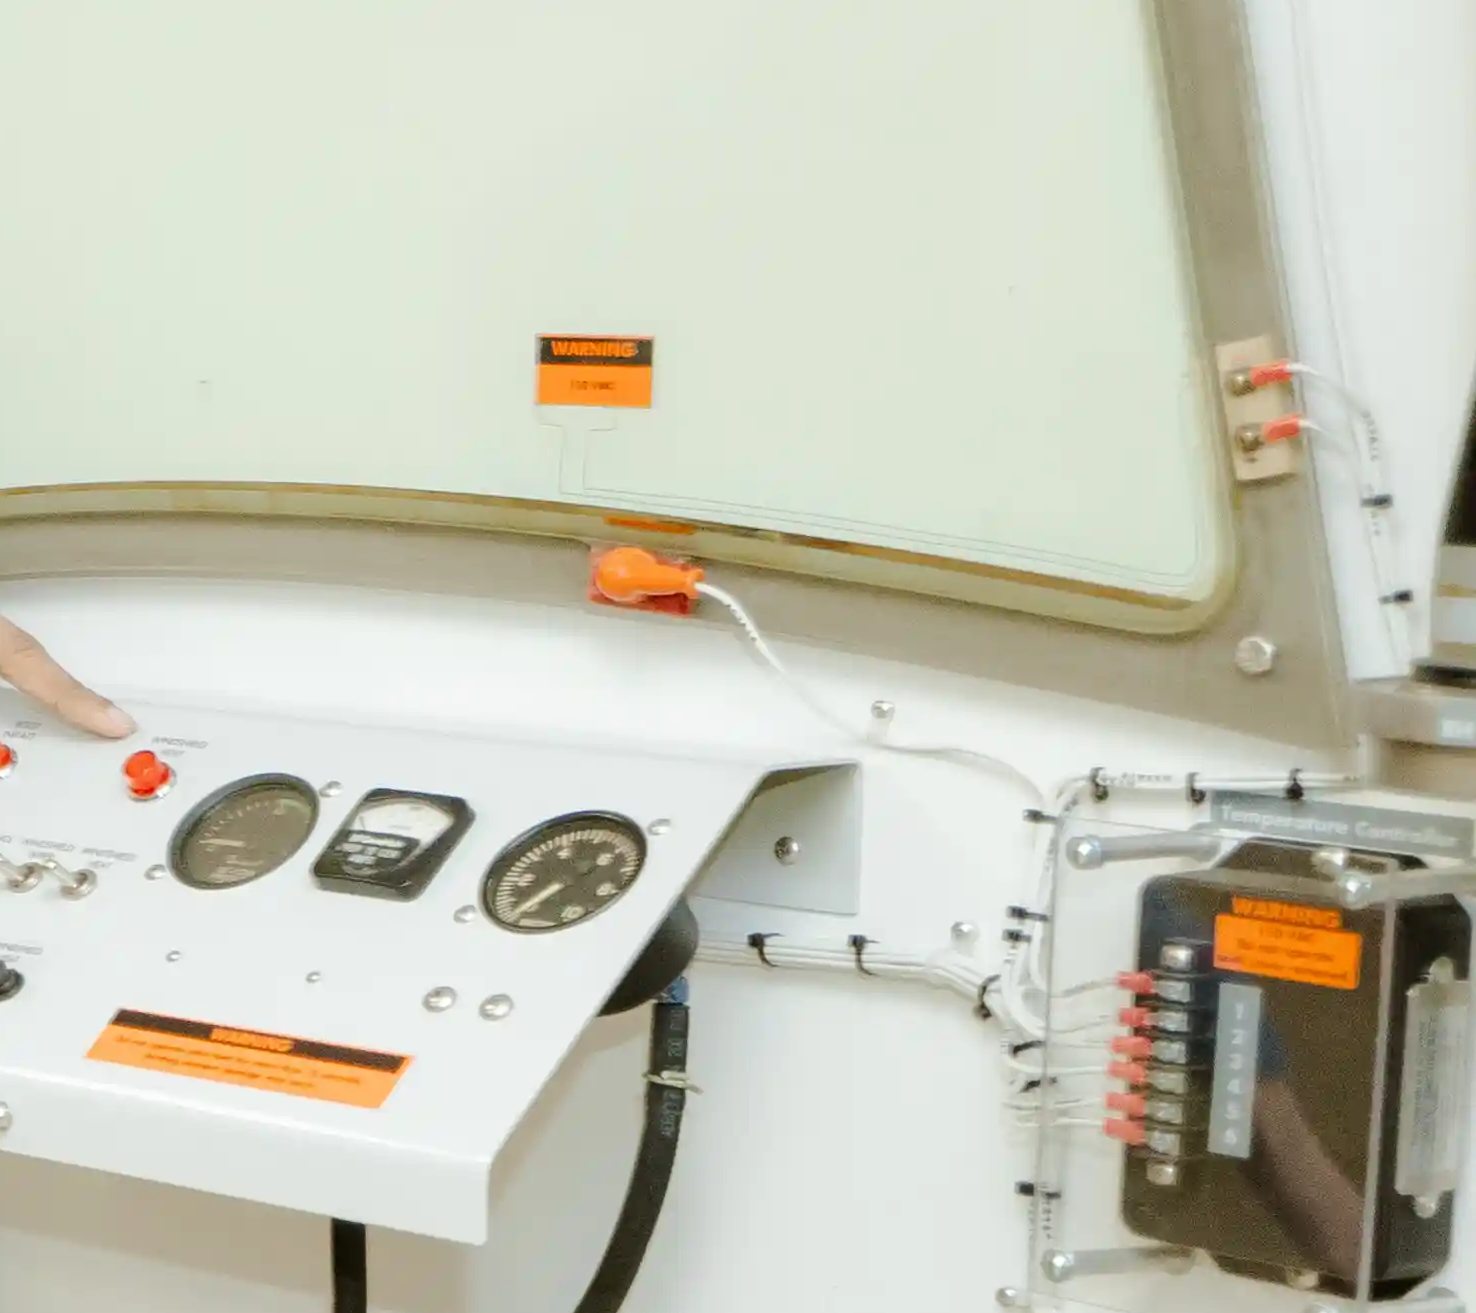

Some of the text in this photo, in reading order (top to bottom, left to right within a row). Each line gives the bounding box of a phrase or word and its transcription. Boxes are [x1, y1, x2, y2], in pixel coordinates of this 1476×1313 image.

[551, 339, 639, 358] WARNING
[1221, 801, 1349, 836] Temperature
[1231, 1029, 1246, 1046] 2
